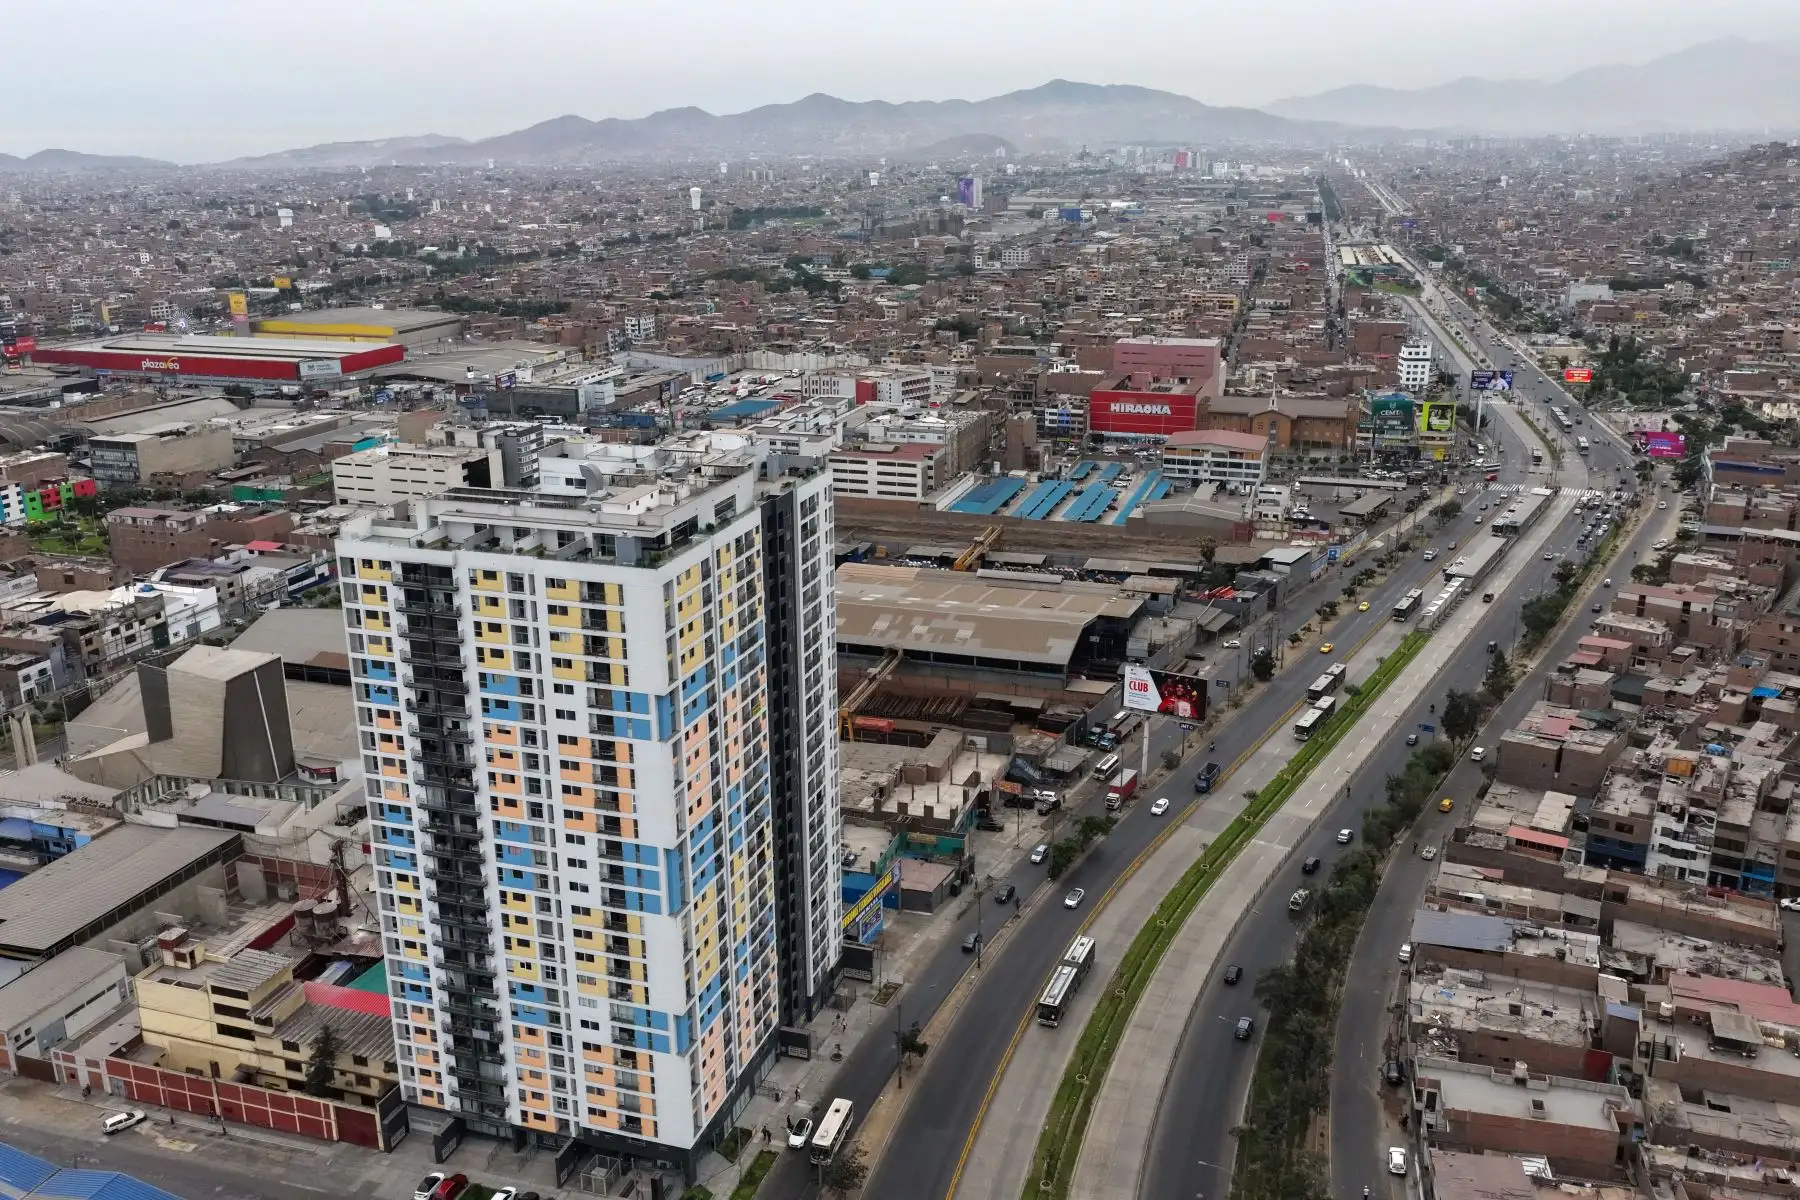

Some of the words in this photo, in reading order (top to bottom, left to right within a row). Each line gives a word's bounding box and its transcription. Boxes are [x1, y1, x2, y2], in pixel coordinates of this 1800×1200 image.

[141, 357, 180, 370] plazavea
[1110, 403, 1172, 415] HIRAOKA
[1129, 681, 1149, 692] CLUB
